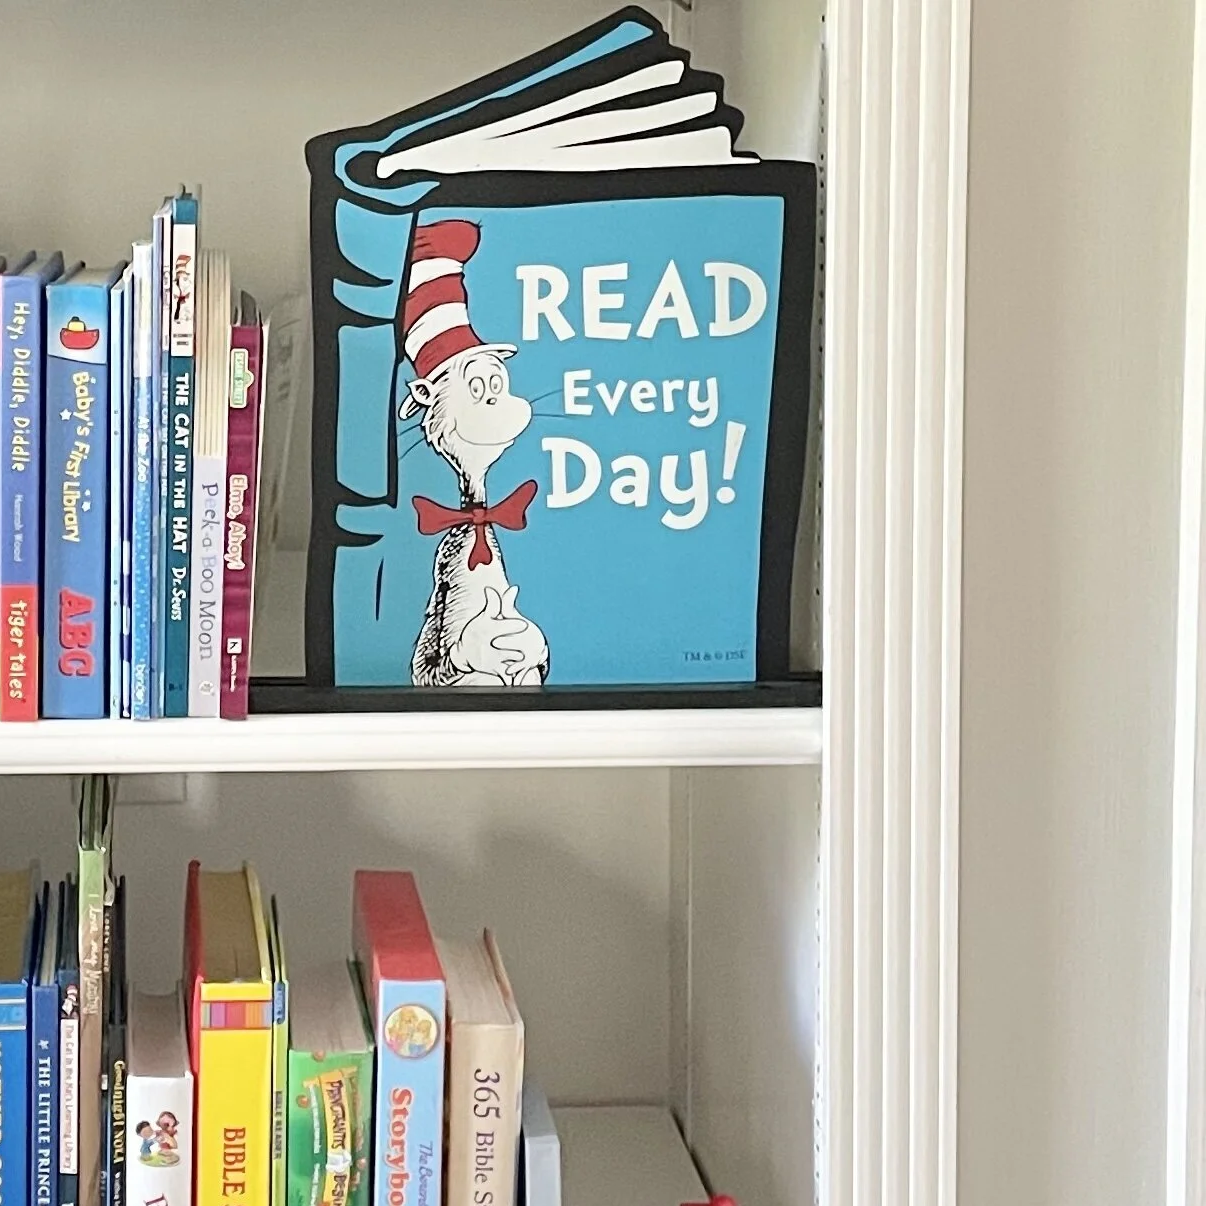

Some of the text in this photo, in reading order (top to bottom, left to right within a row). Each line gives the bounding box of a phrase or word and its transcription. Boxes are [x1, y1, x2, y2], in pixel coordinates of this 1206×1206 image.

[515, 260, 768, 341] READ
[10, 301, 31, 471] Hey, Diddle, Diddle
[563, 369, 719, 428] Every
[62, 371, 94, 543] Baby's First Library
[172, 373, 190, 553] THE CAT IN THE HAT
[541, 419, 747, 530] Day!
[226, 475, 246, 570] Elmo, Ahoy!
[170, 566, 186, 621] Dr. Seuss
[198, 600, 219, 660] Moon
[9, 600, 28, 699] tiger tales
[58, 588, 94, 677] ABC
[38, 1056, 51, 1089] THE
[473, 1068, 500, 1119] 365
[38, 1092, 51, 1144] LITTLE
[221, 1127, 247, 1196] BIBLE
[472, 1131, 495, 1184] Bible
